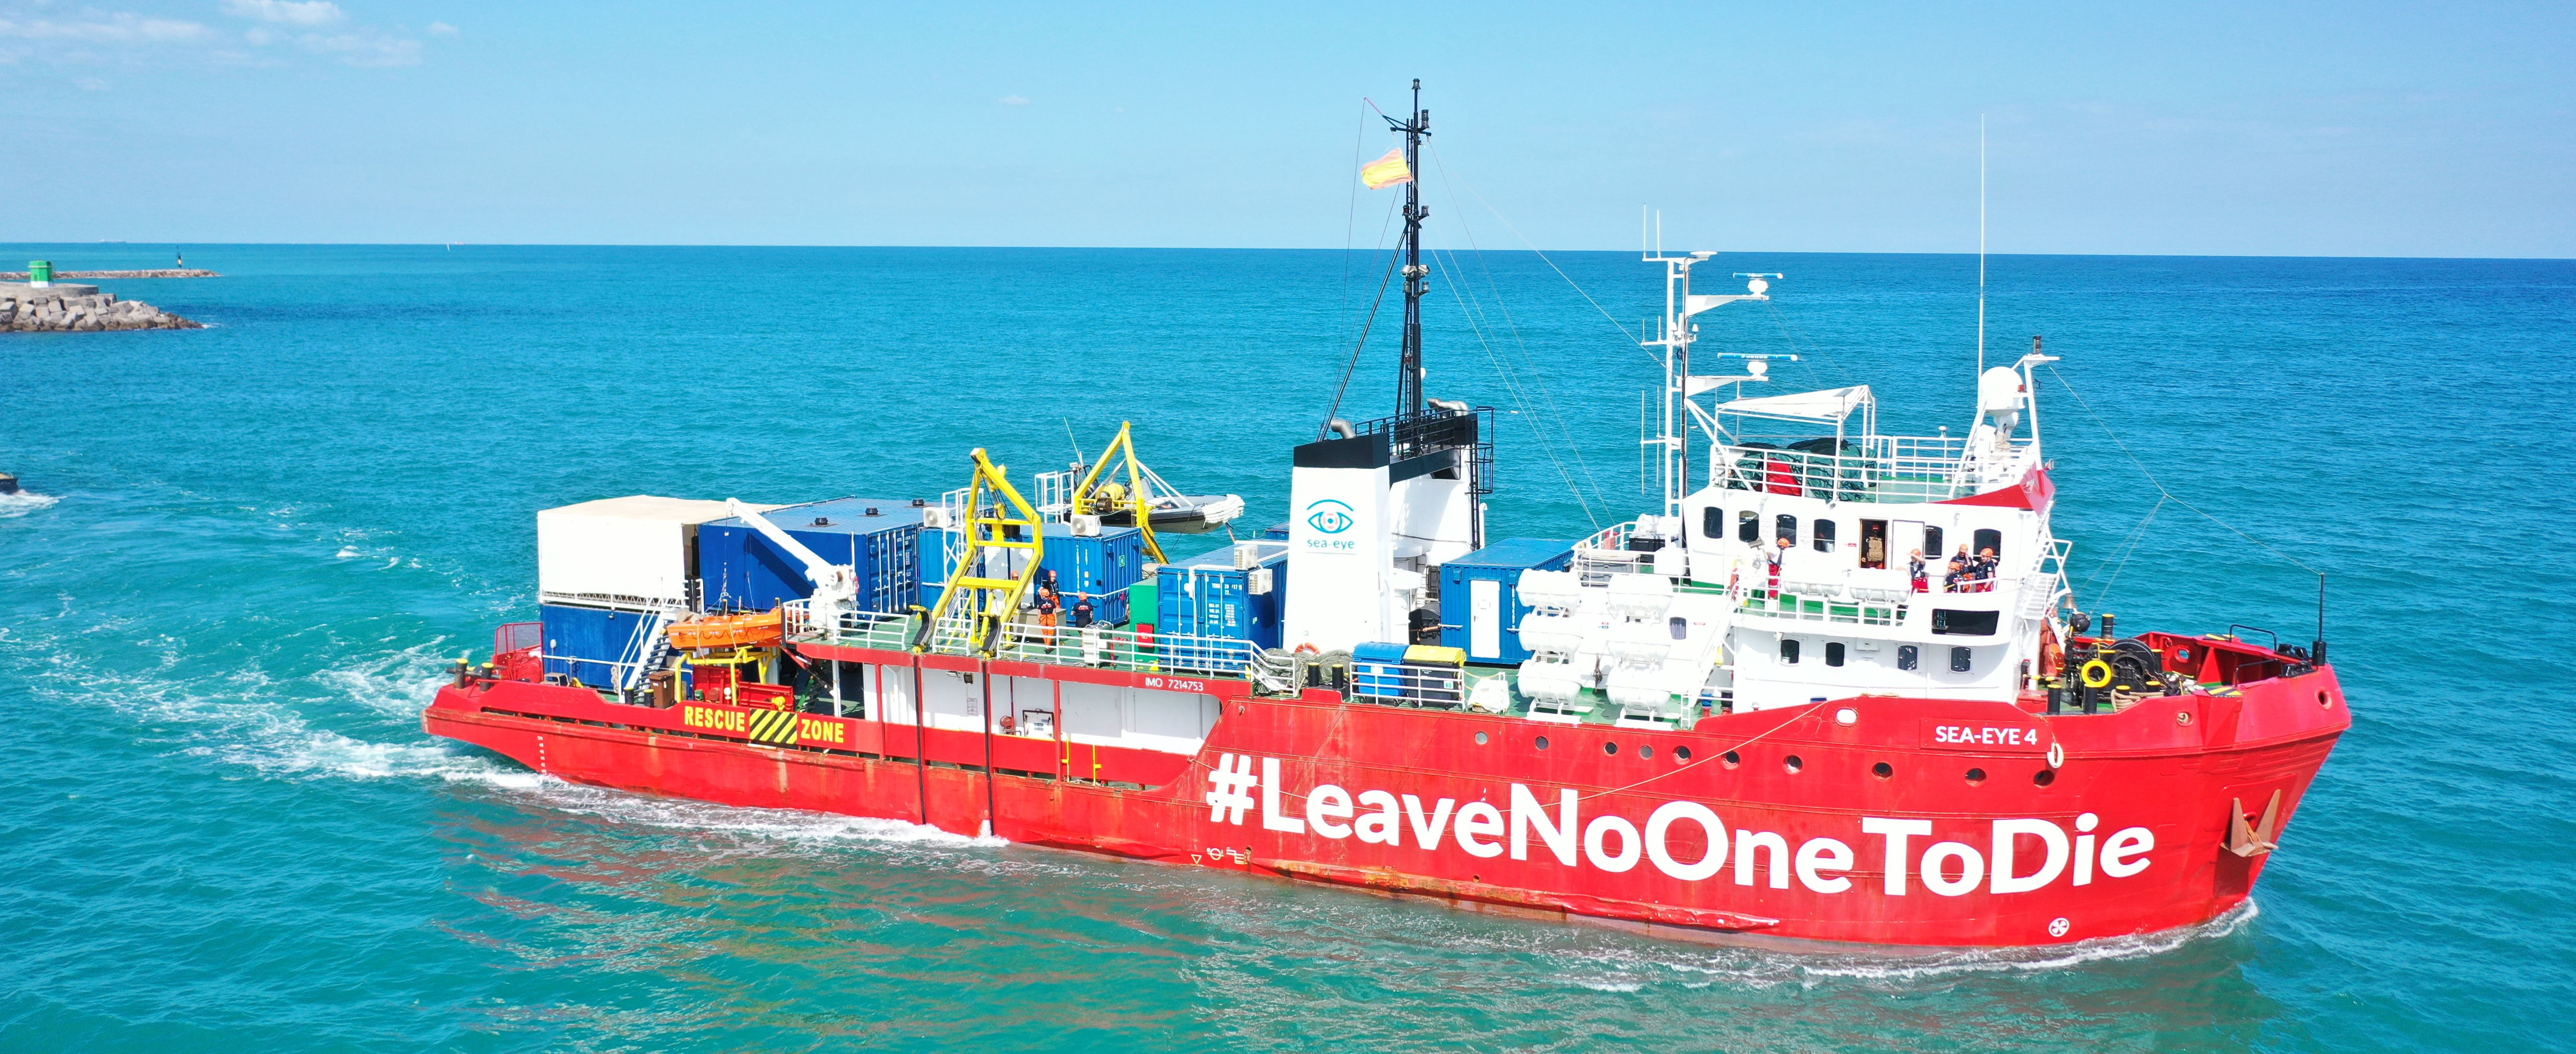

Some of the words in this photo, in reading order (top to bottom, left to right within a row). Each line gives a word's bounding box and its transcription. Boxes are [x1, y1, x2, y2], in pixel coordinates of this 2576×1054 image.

[1307, 539, 1354, 551] sea-eye
[1145, 677, 1163, 687] IMO
[1168, 679, 1204, 691] 7214753
[684, 706, 745, 732] RESCUE
[800, 719, 844, 743] ZONE
[1935, 726, 2021, 745] SEA-EYE
[2024, 729, 2038, 745] 4
[1205, 753, 2154, 896] #LeaveNoOneToDie
